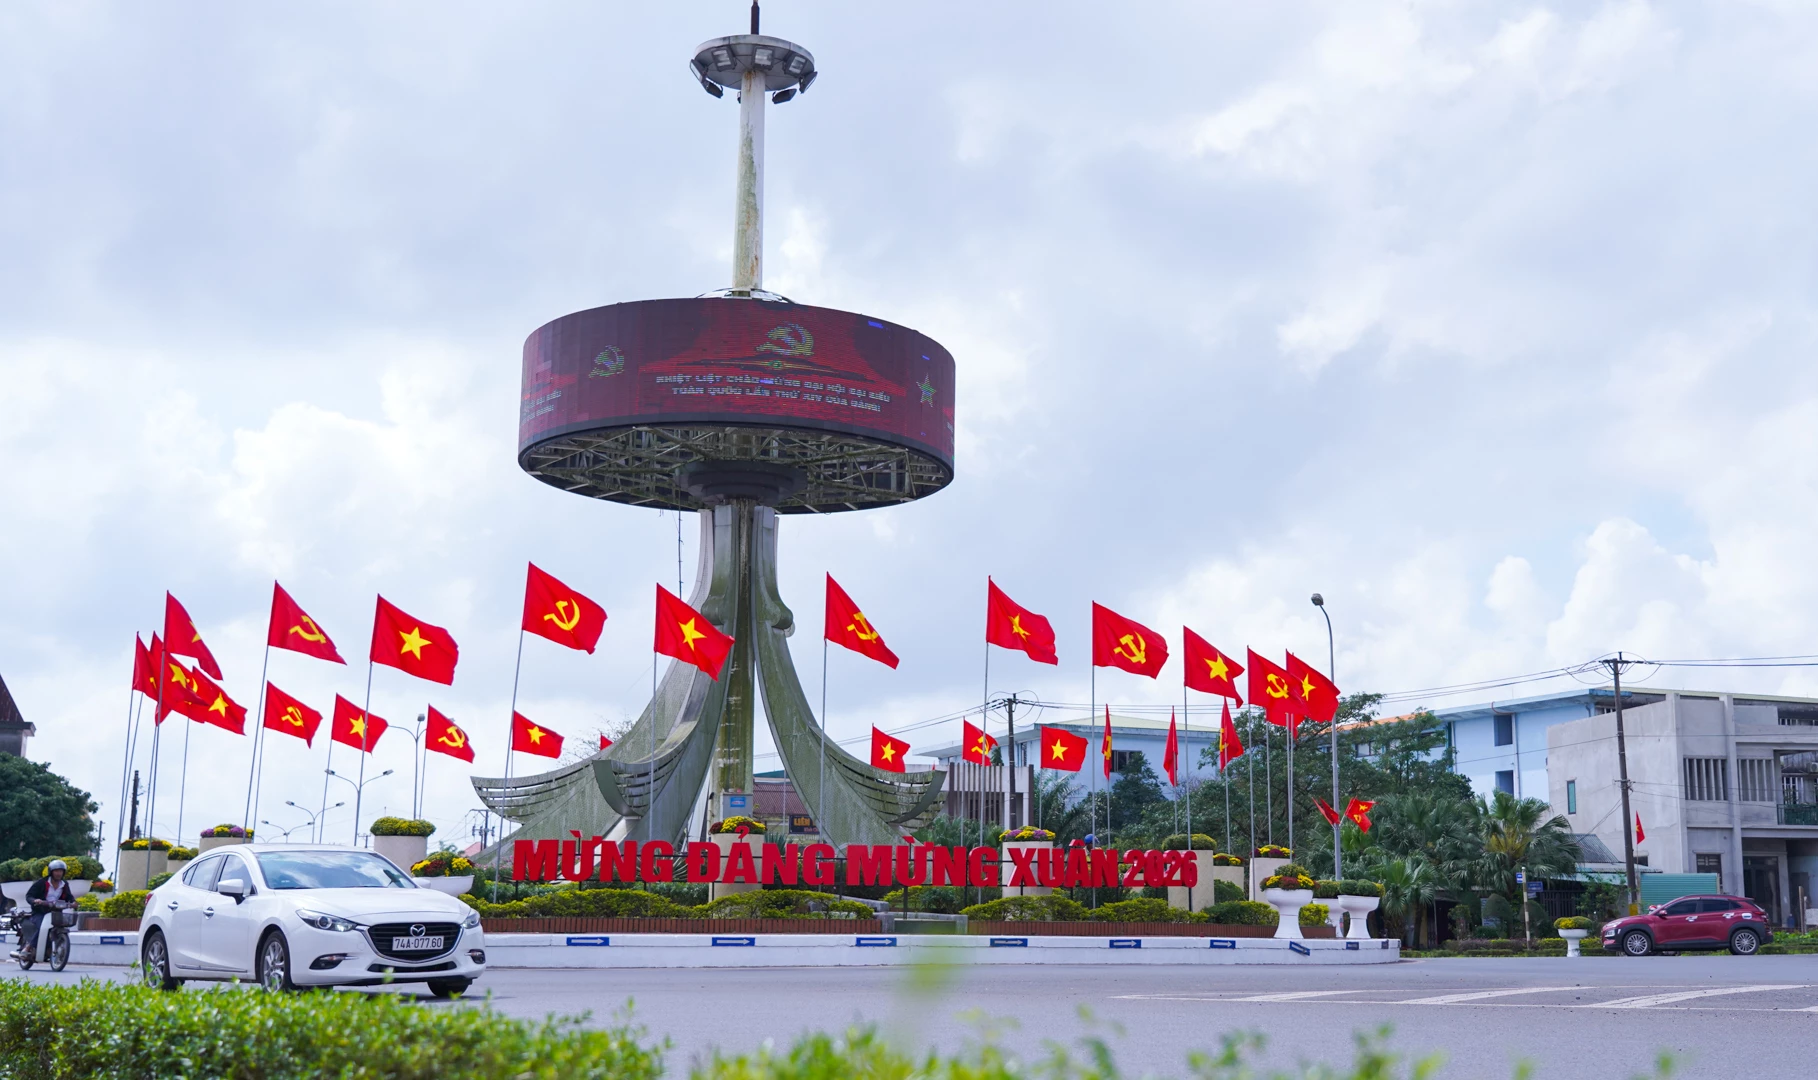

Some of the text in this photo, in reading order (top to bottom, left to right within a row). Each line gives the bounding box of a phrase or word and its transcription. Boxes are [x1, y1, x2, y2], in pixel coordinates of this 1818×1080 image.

[512, 825, 1198, 888] MỪNG ĐẢNG MỪNG XUÂN 2026
